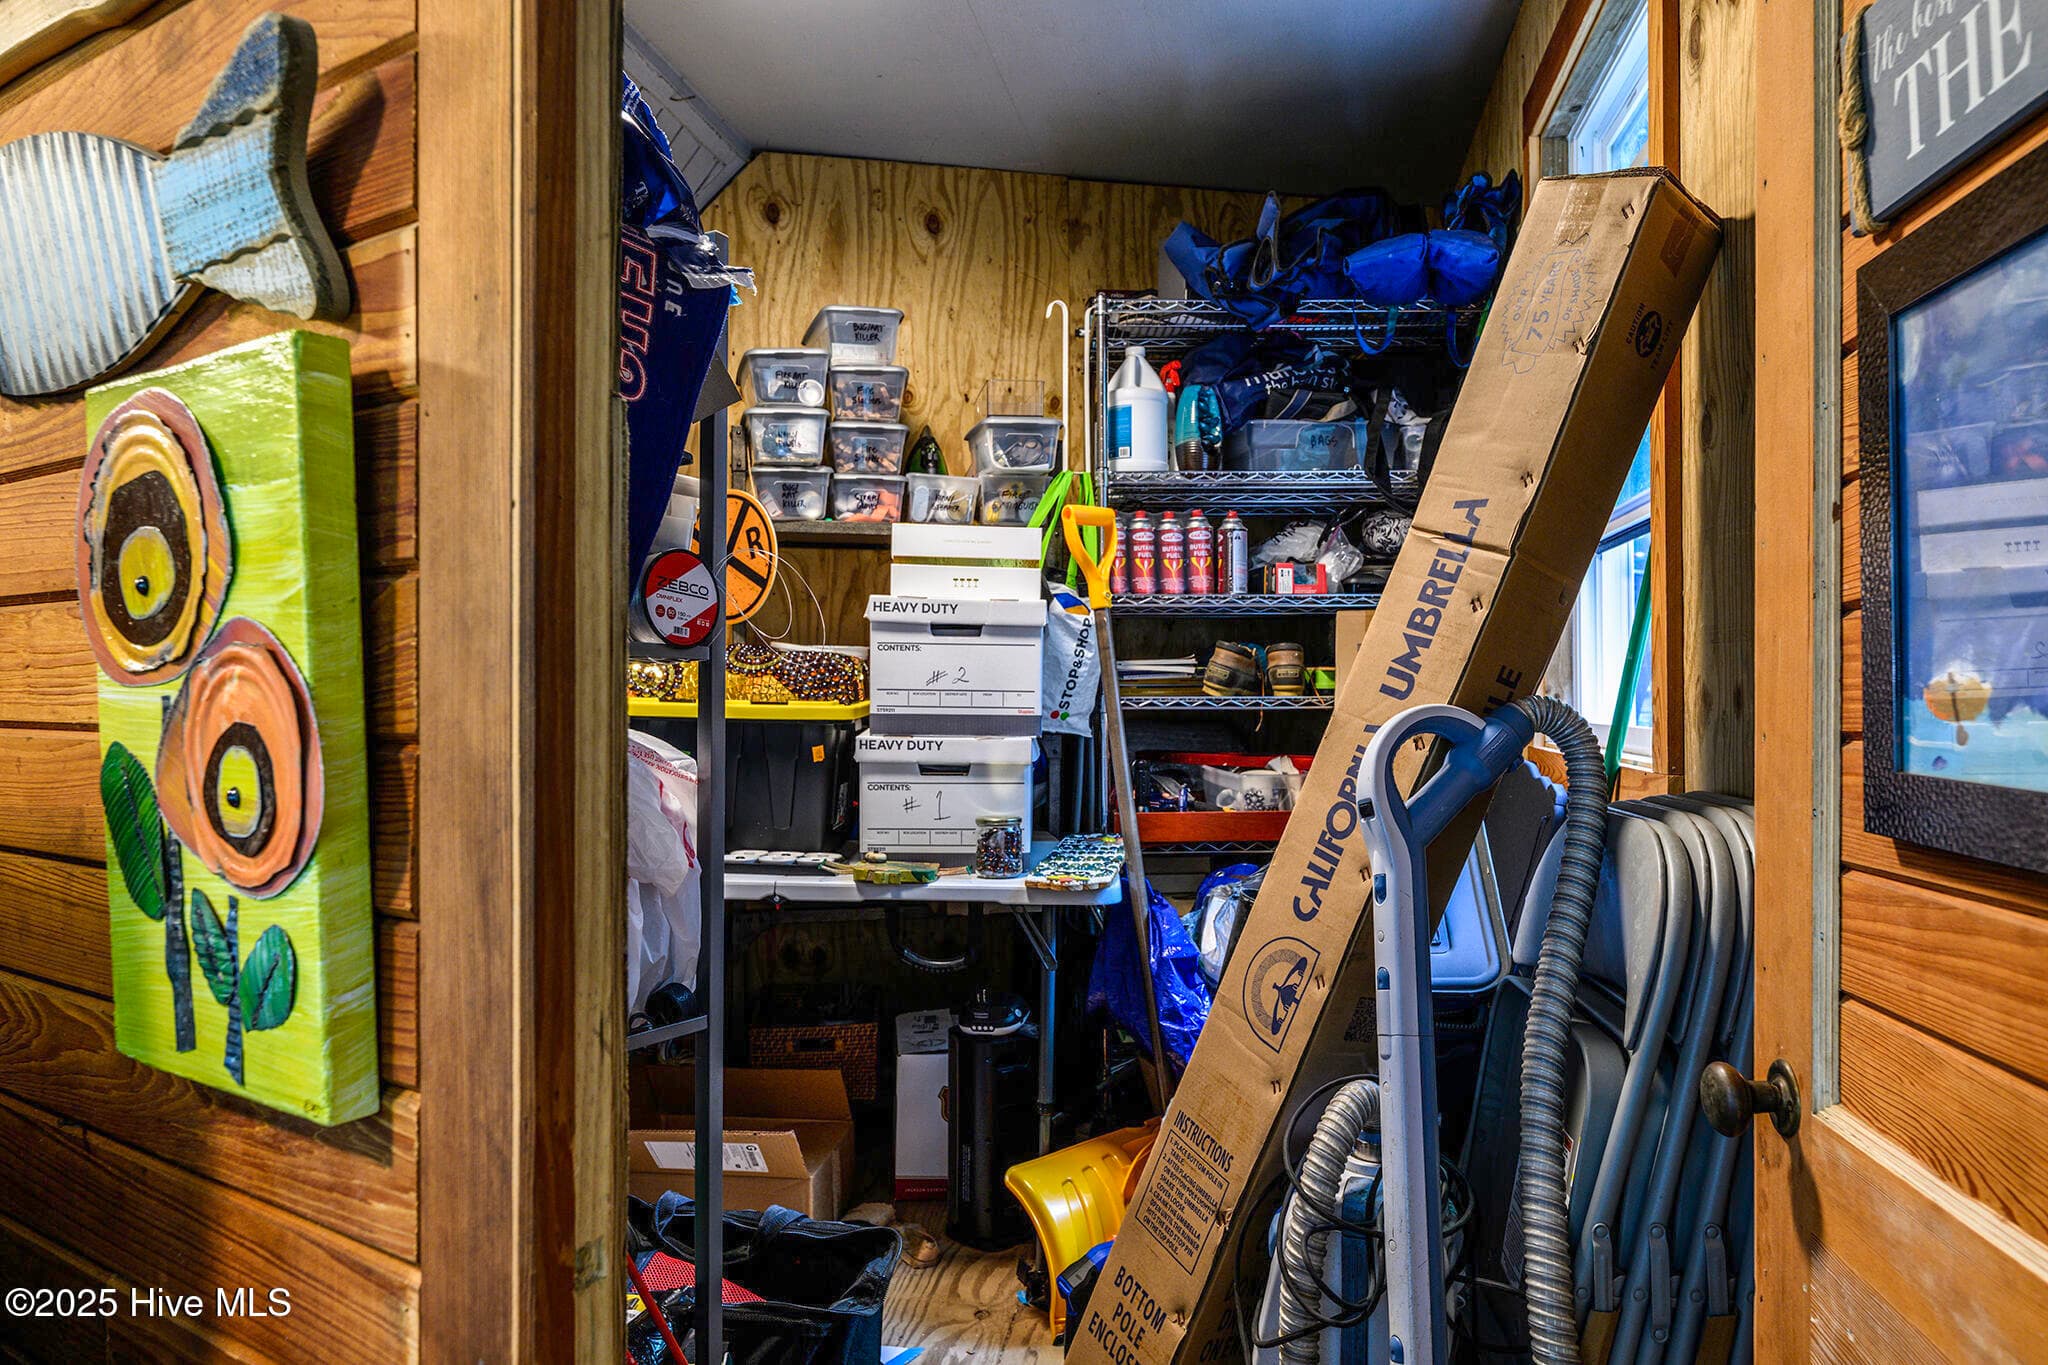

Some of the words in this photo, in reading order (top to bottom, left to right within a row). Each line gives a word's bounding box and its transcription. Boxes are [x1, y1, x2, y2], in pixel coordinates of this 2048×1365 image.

[1893, 0, 2033, 161] THE
[1512, 288, 1529, 321] OVER
[1526, 310, 1549, 341] 75
[1540, 260, 1564, 304] YEARS
[1563, 306, 1574, 321] OF
[854, 332, 881, 342] KILLER
[1626, 303, 1646, 345] CAUTION
[745, 526, 765, 560] R
[656, 576, 709, 597] ZEBCO
[1379, 498, 1489, 701] UMBRELLA
[872, 601, 918, 614] HEAVY
[922, 603, 958, 615] DUTY
[877, 644, 922, 652] CONTENTS:
[1058, 617, 1092, 711] STOP&SHOP
[926, 670, 948, 686] #
[952, 666, 969, 685] 2
[859, 739, 904, 751] HEAVY
[907, 740, 944, 751] DUTY
[867, 784, 911, 792] CONTENTS:
[903, 796, 921, 813] #
[933, 791, 951, 820] 1
[1293, 724, 1380, 922] CALIFORNI
[1174, 1110, 1234, 1173] INSTRUCTIONS
[1183, 1195, 1209, 1224] UMBRELLA
[1175, 1212, 1201, 1241] UMBRELLA
[1114, 1265, 1167, 1334] BOTTOM
[1088, 1311, 1140, 1365] ENCLOS
[1112, 1302, 1146, 1350] POLE
